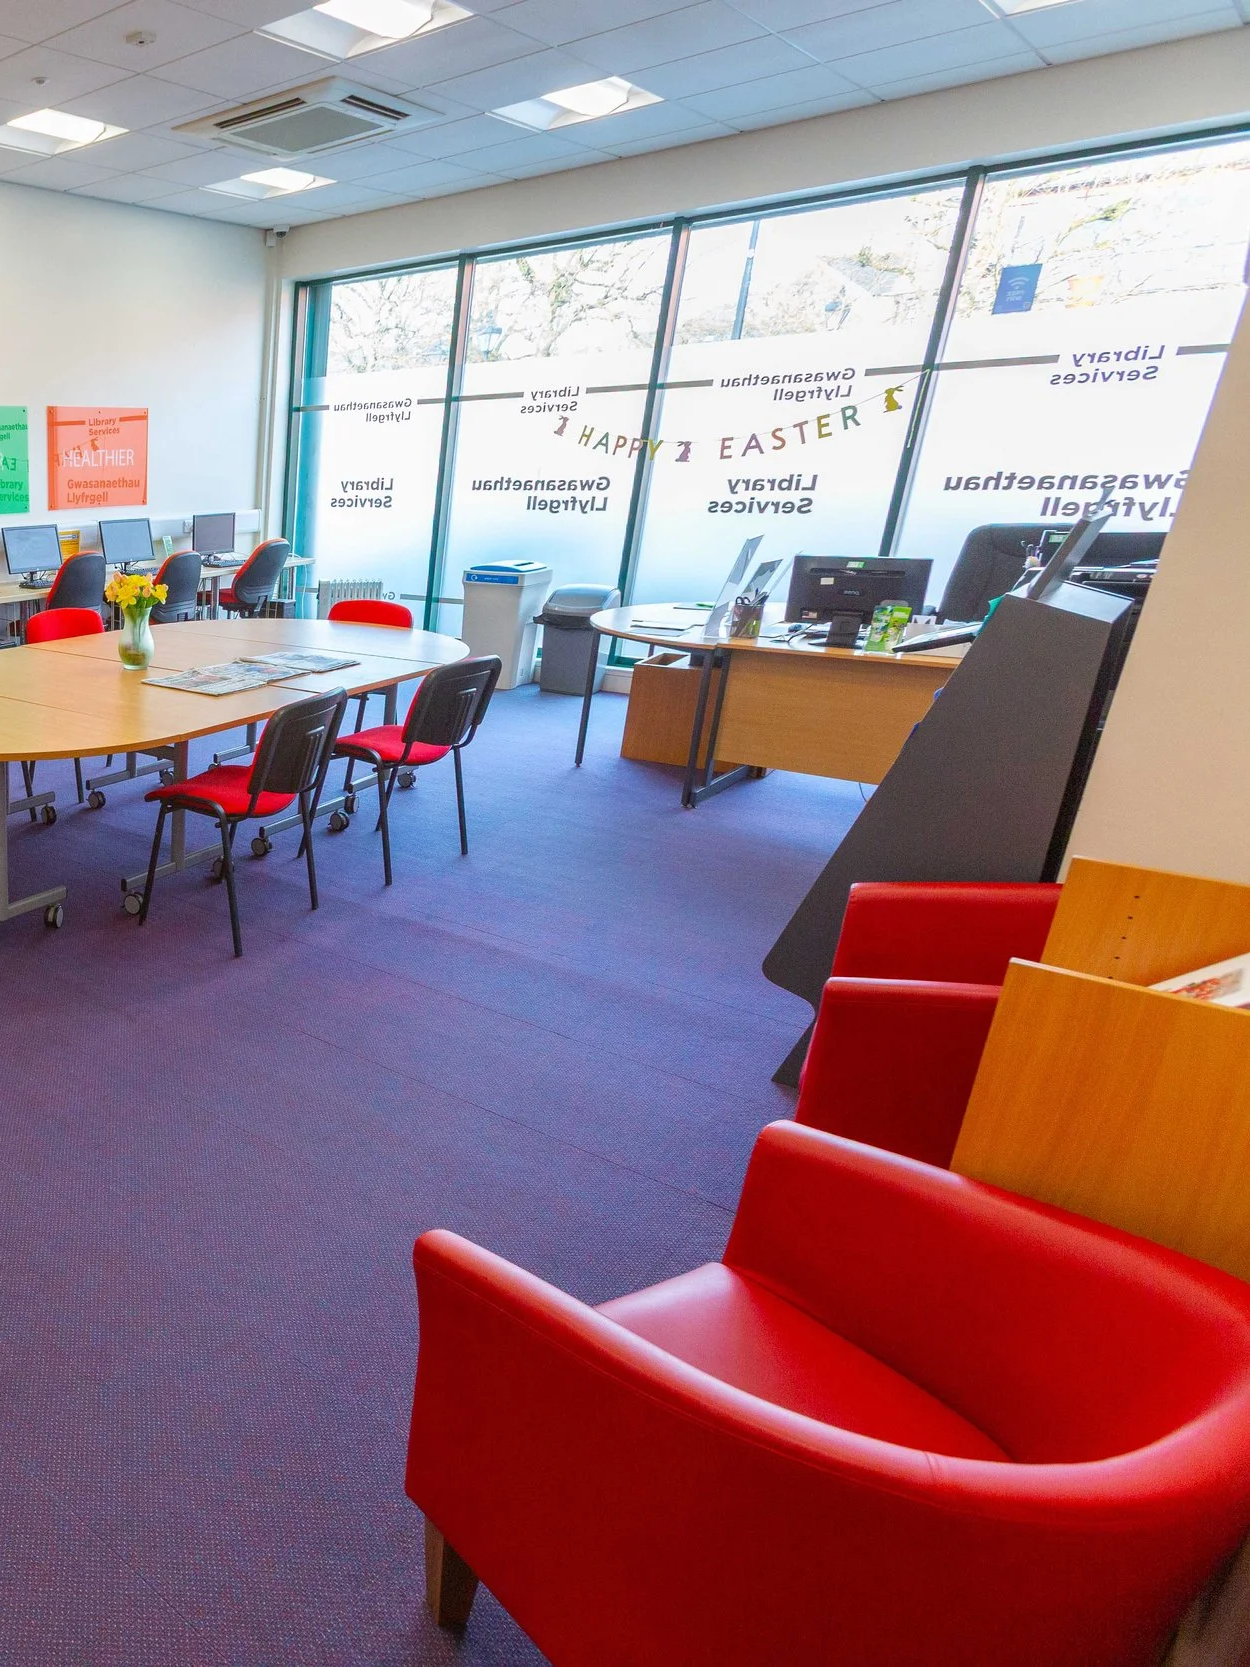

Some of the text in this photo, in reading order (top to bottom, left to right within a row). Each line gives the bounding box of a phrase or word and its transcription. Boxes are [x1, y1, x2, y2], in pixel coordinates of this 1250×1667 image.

[88, 418, 117, 427] Library
[89, 427, 120, 436] Services
[578, 405, 861, 461] HAPPY EASTER
[62, 449, 135, 468] HEALTHIER
[67, 477, 140, 489] Gwasanaethau
[67, 492, 108, 504] Llyfrgell
